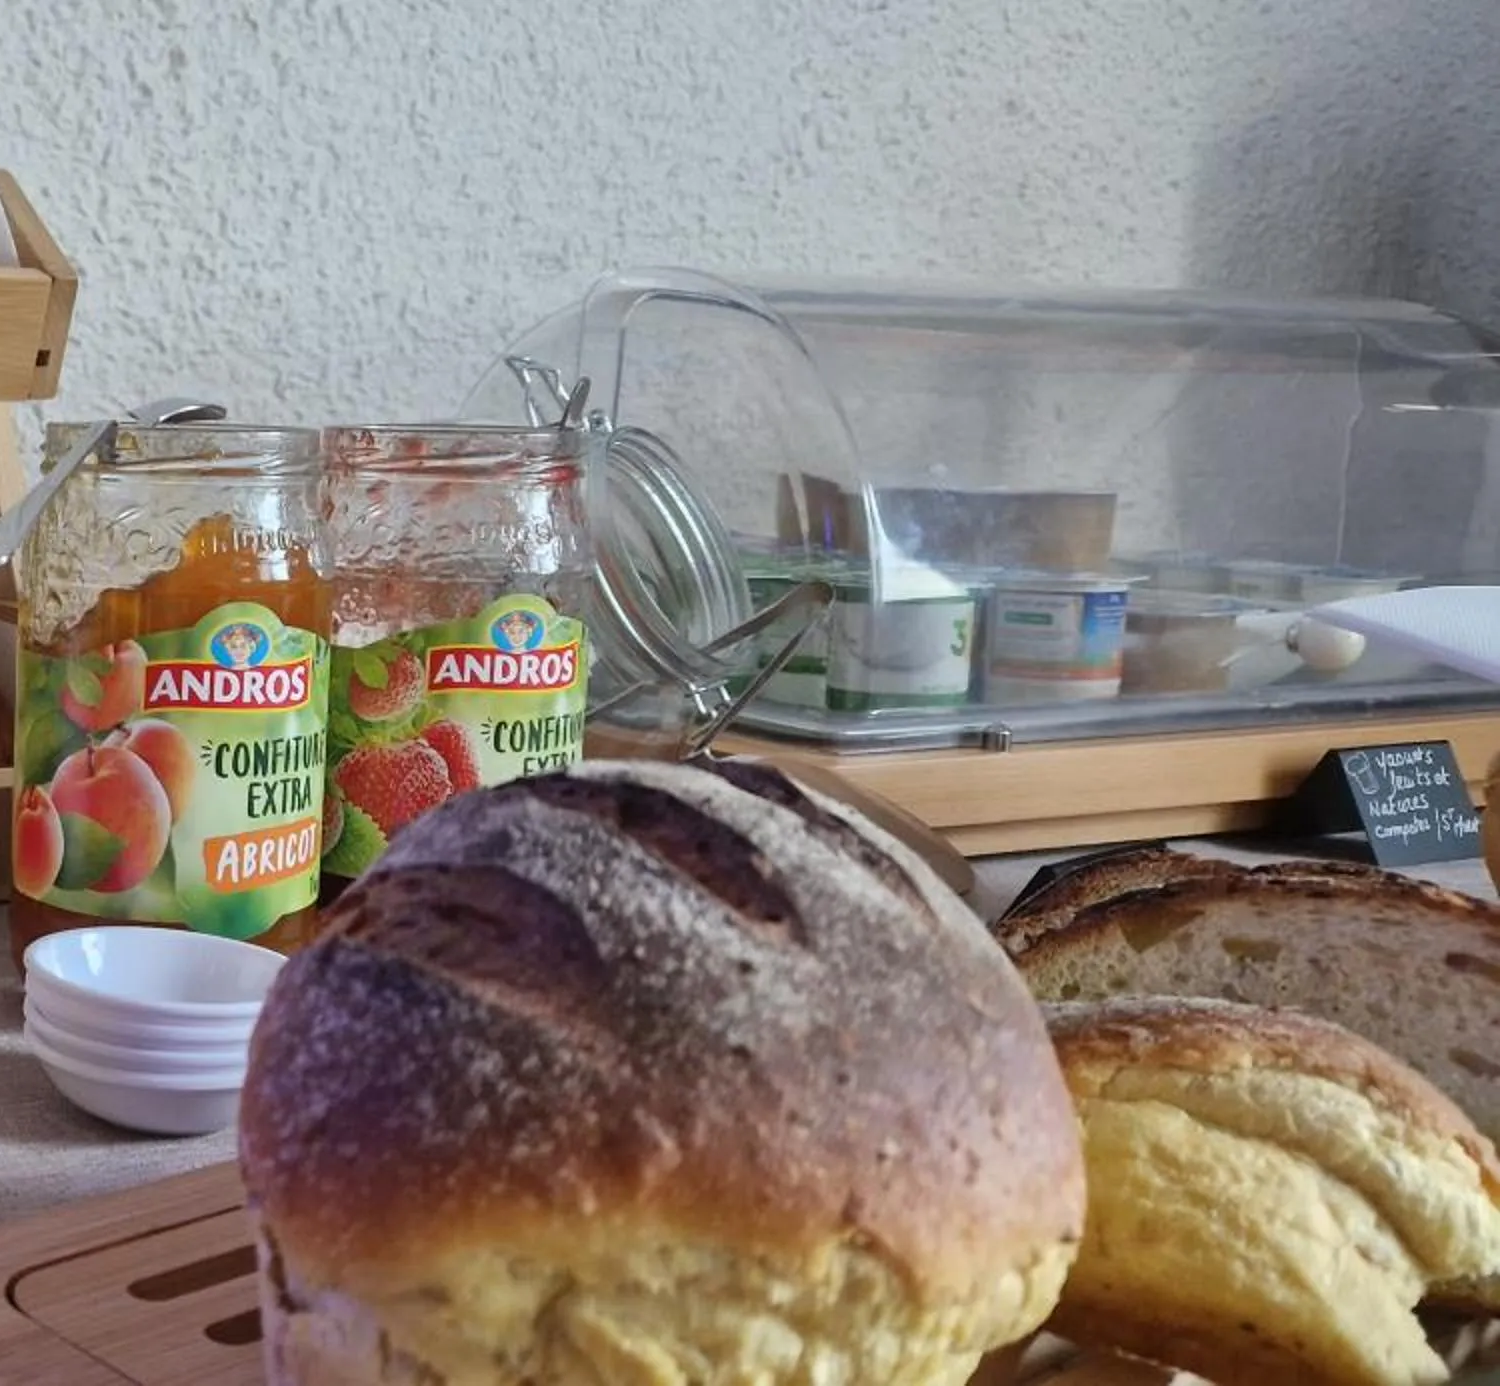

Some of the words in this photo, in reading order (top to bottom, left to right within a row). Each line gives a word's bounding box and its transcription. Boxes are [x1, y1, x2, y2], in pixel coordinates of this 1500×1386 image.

[149, 665, 306, 705] ANDROS
[432, 649, 574, 686] ANDROS
[1433, 765, 1451, 786] et
[247, 775, 312, 819] EXTRA
[216, 823, 317, 883] ABRICOT
